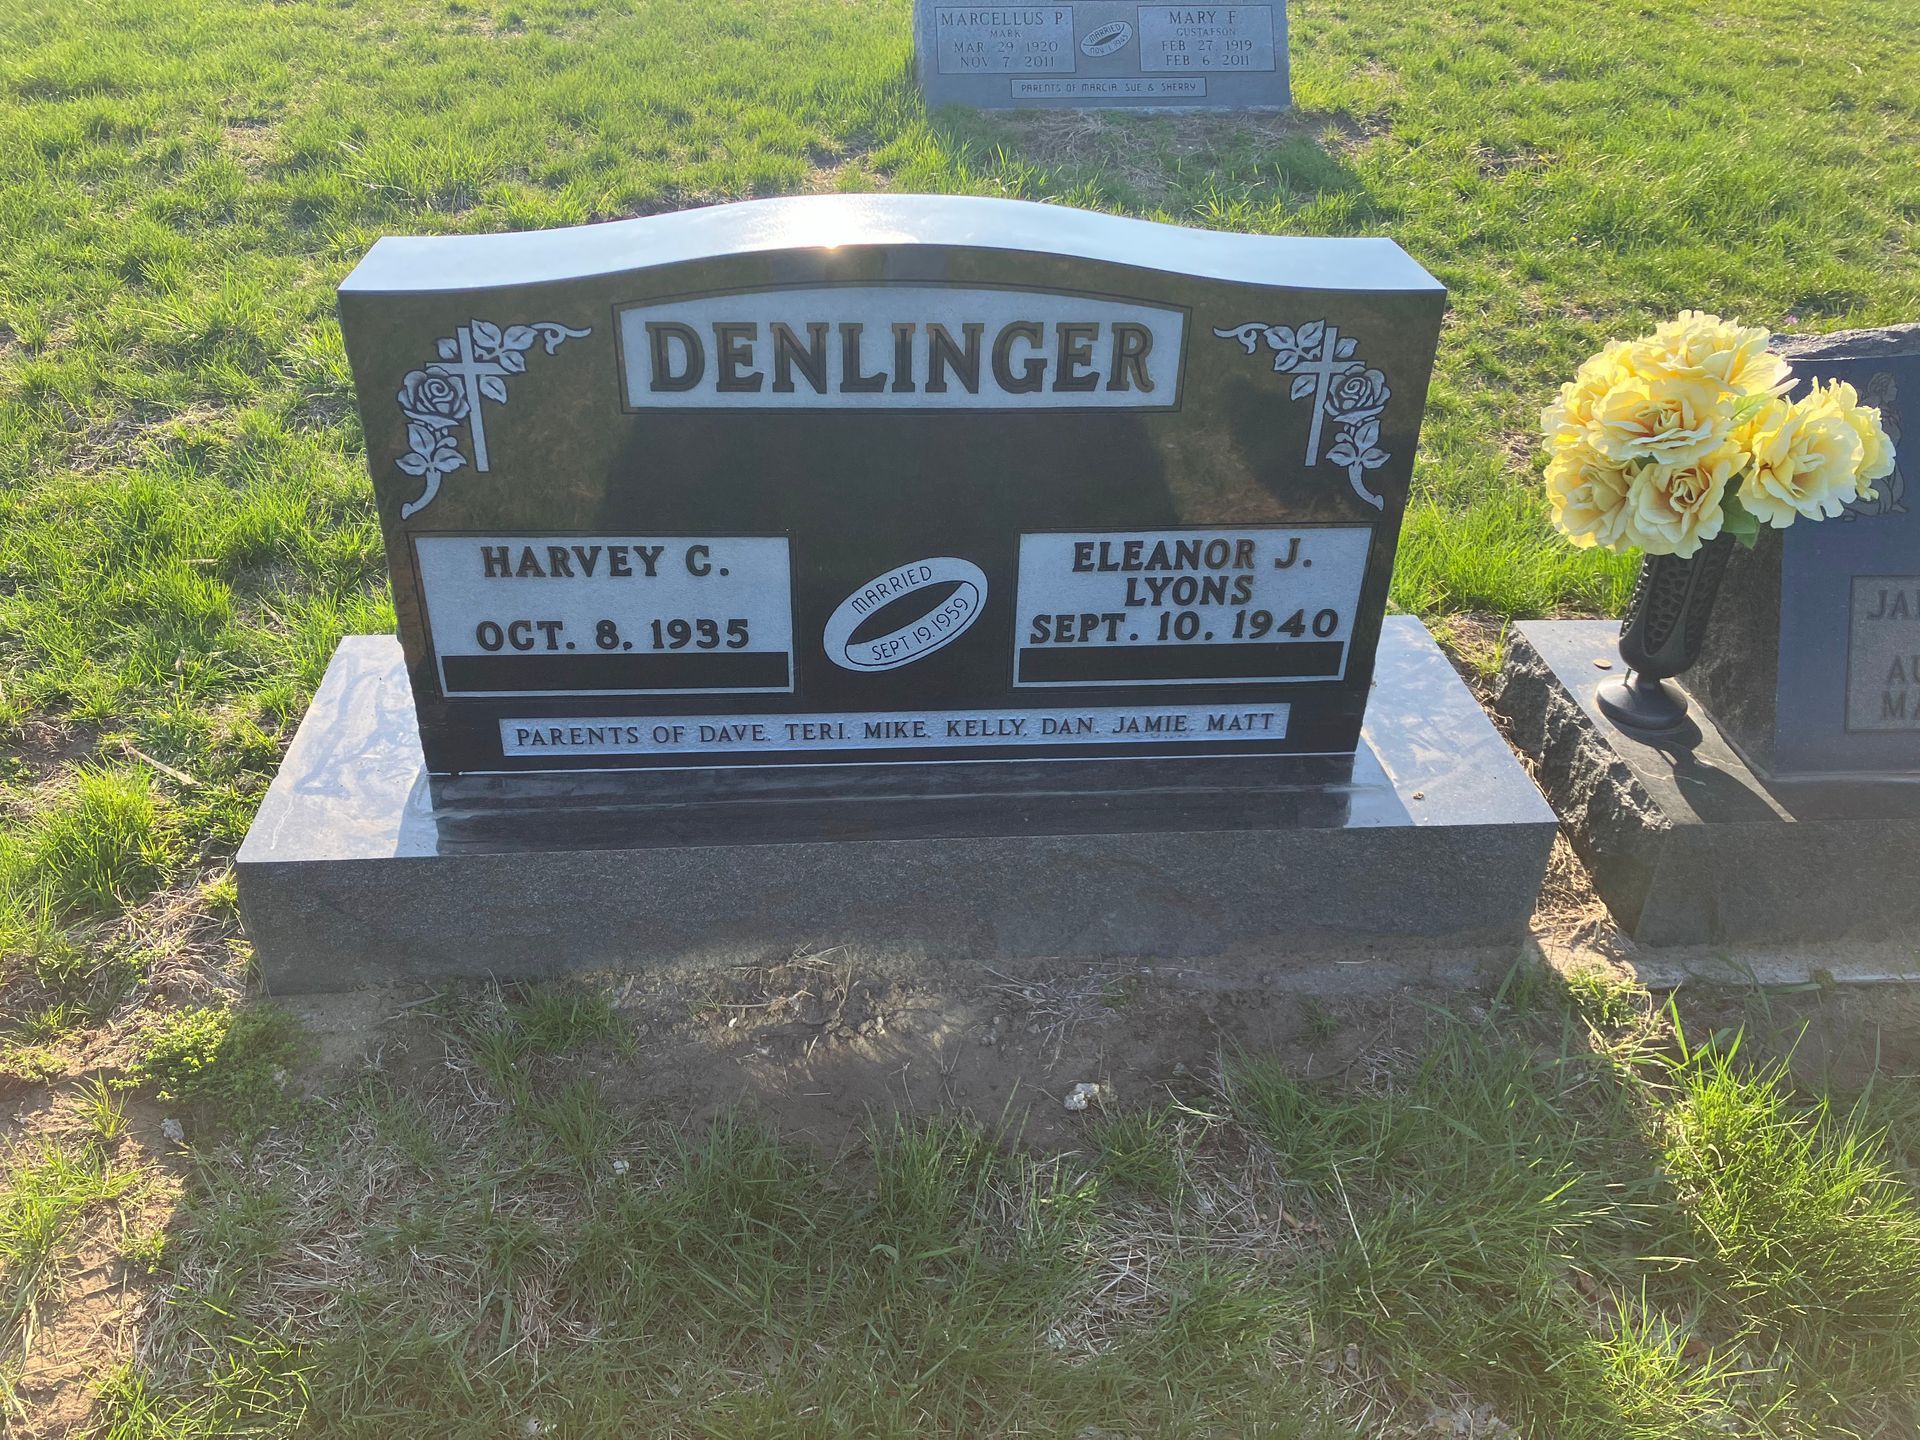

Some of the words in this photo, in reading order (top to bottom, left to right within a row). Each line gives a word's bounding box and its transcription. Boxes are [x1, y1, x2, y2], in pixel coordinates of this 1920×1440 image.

[942, 12, 1044, 25] MARCELLUS
[1169, 11, 1216, 24] MARY
[990, 29, 1022, 38] MARK
[1089, 24, 1121, 43] MARRIED
[1176, 28, 1236, 37] GUSTAFSON
[954, 42, 984, 53] MAR
[1027, 41, 1058, 52] 1920
[1161, 40, 1186, 51] FEB
[1226, 40, 1252, 50] 1919
[960, 57, 989, 68] NOV
[1024, 56, 1054, 67] 2011
[1166, 55, 1190, 66] FEB
[1222, 54, 1249, 65] 2011
[1021, 83, 1061, 92] PARENTS
[1066, 83, 1077, 92] OF
[1126, 83, 1142, 92] SUE
[1161, 82, 1196, 91] SHERRY
[645, 320, 1155, 394] DENLINGER
[481, 546, 664, 578] HARVEY
[685, 545, 730, 577] C.
[1072, 539, 1255, 572] ELEANOR
[1274, 537, 1312, 568] J.
[852, 566, 932, 614] MARRIED
[1124, 575, 1254, 606] LYONS
[931, 598, 969, 631] 1959
[1866, 589, 1920, 620] JA
[476, 619, 577, 651] OCT.
[652, 618, 750, 649] 1935
[1030, 612, 1139, 644] SEPT.
[1232, 608, 1339, 639] 1940
[516, 726, 639, 747] PARENTS
[652, 726, 686, 744] OF
[1206, 712, 1275, 732] MATT
